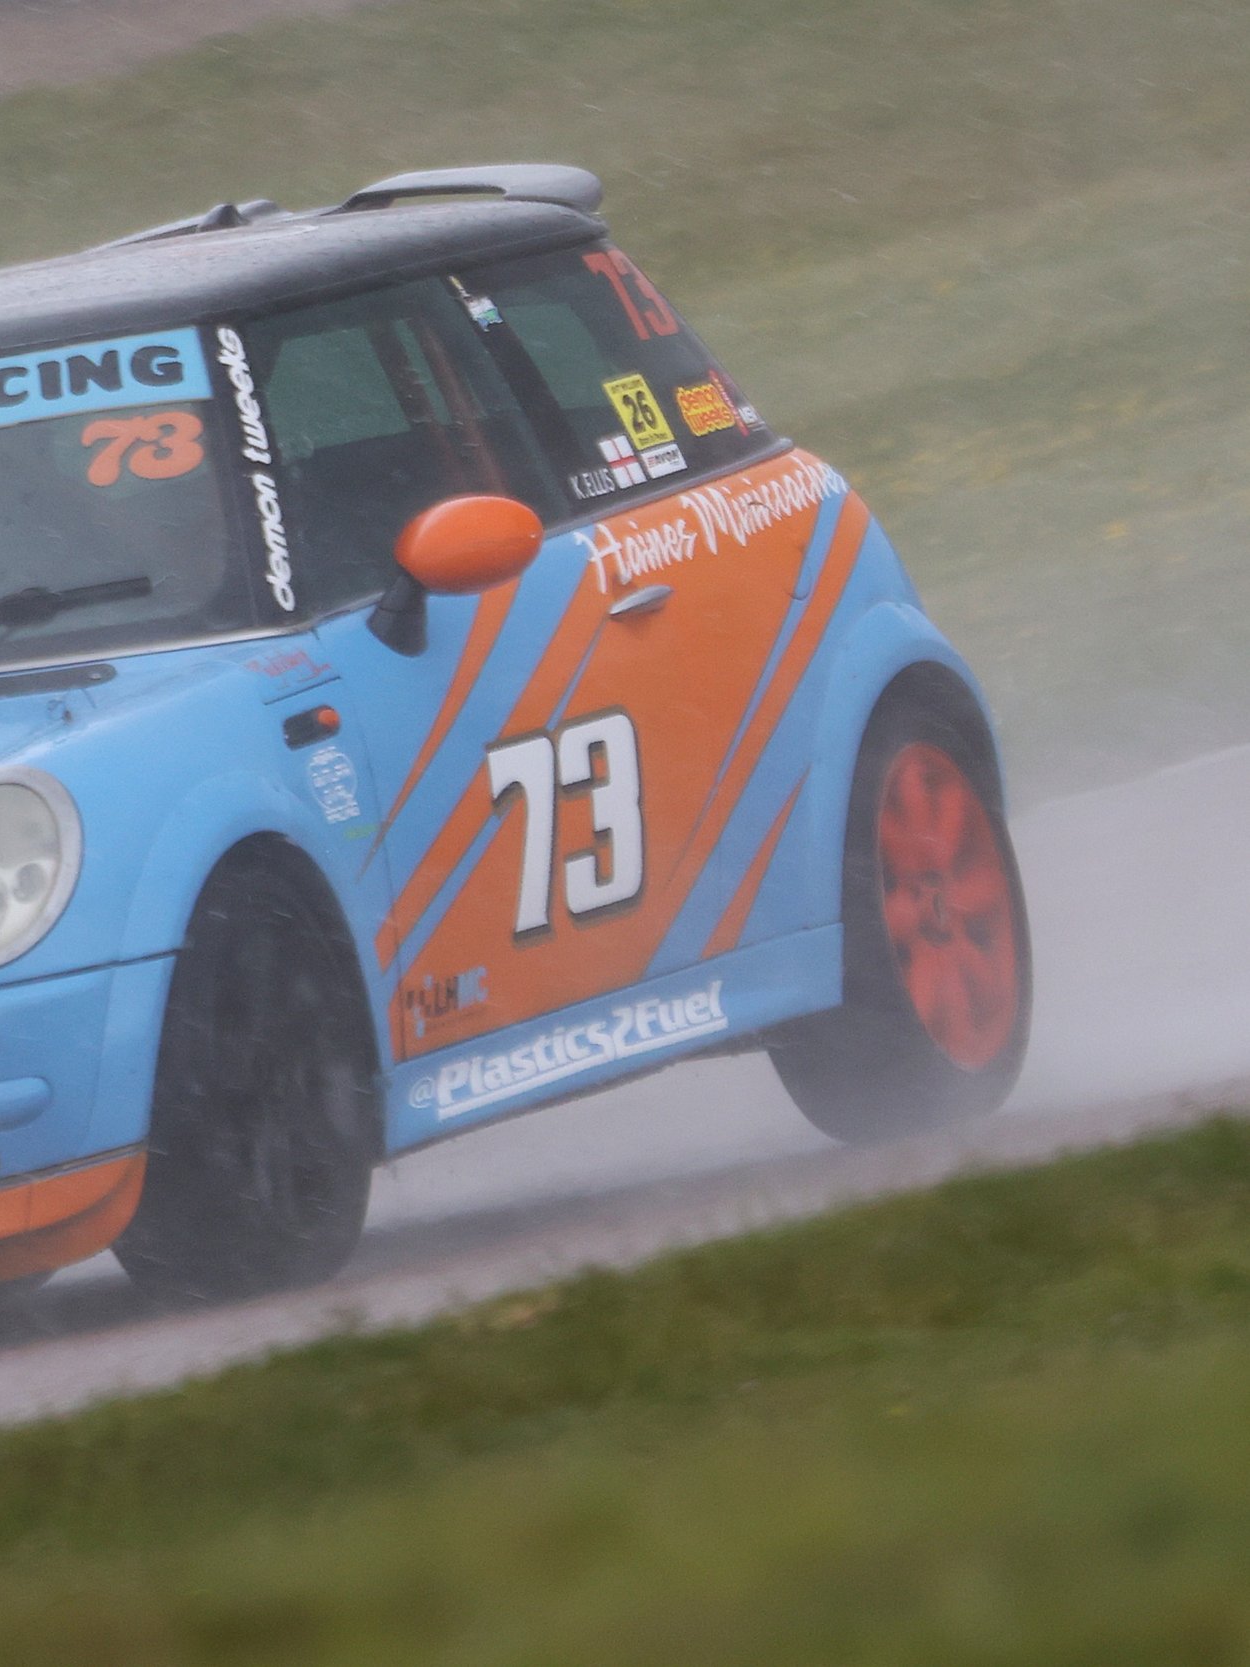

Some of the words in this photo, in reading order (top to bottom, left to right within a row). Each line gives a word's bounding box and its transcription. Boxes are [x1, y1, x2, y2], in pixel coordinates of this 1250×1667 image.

[582, 250, 679, 340] 73
[216, 326, 272, 464] tweeks
[621, 390, 658, 434] 26
[81, 411, 204, 486] 73
[569, 467, 616, 500] K.ELLIS
[253, 473, 296, 612] demon
[574, 523, 698, 594] Haines
[486, 708, 644, 938] 73
